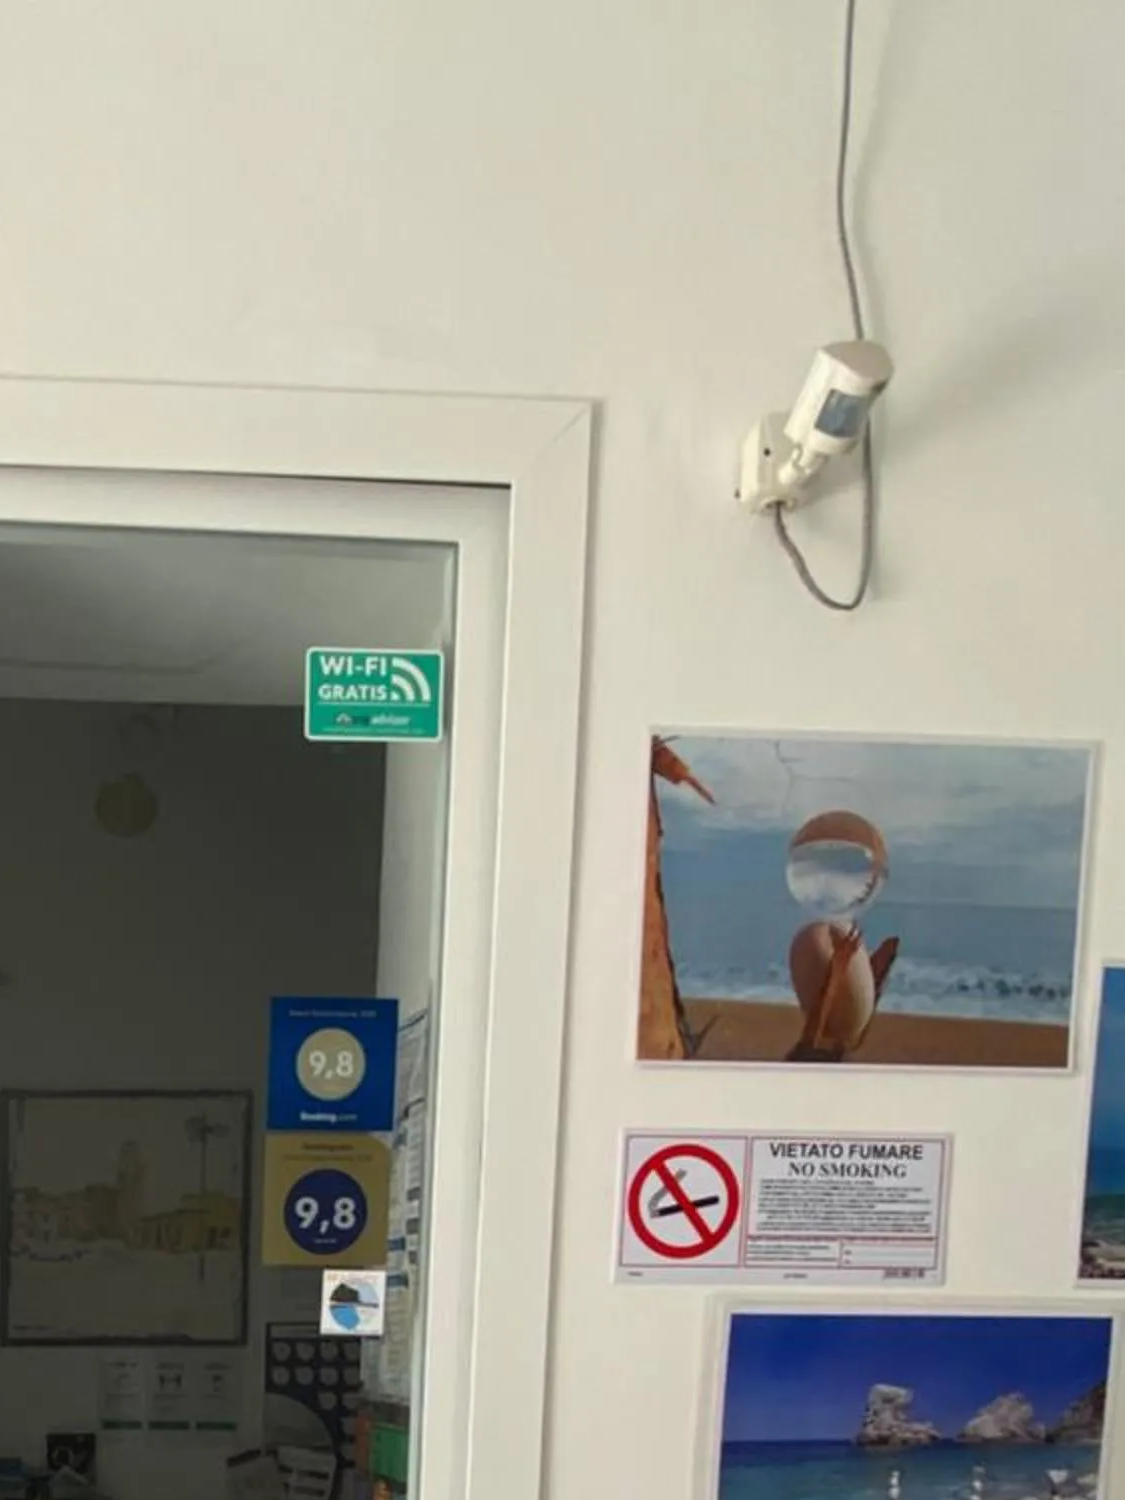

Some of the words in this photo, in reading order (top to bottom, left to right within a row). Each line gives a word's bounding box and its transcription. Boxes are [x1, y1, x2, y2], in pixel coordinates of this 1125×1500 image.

[318, 655, 387, 677] WI-FI
[318, 683, 388, 701] GRATIS
[308, 1051, 354, 1079] 9,8
[769, 1142, 844, 1159] VIETATO
[848, 1143, 924, 1161] FUMARE
[787, 1162, 817, 1177] NO
[819, 1163, 907, 1179] SMOKING
[294, 1196, 356, 1234] 9,8
